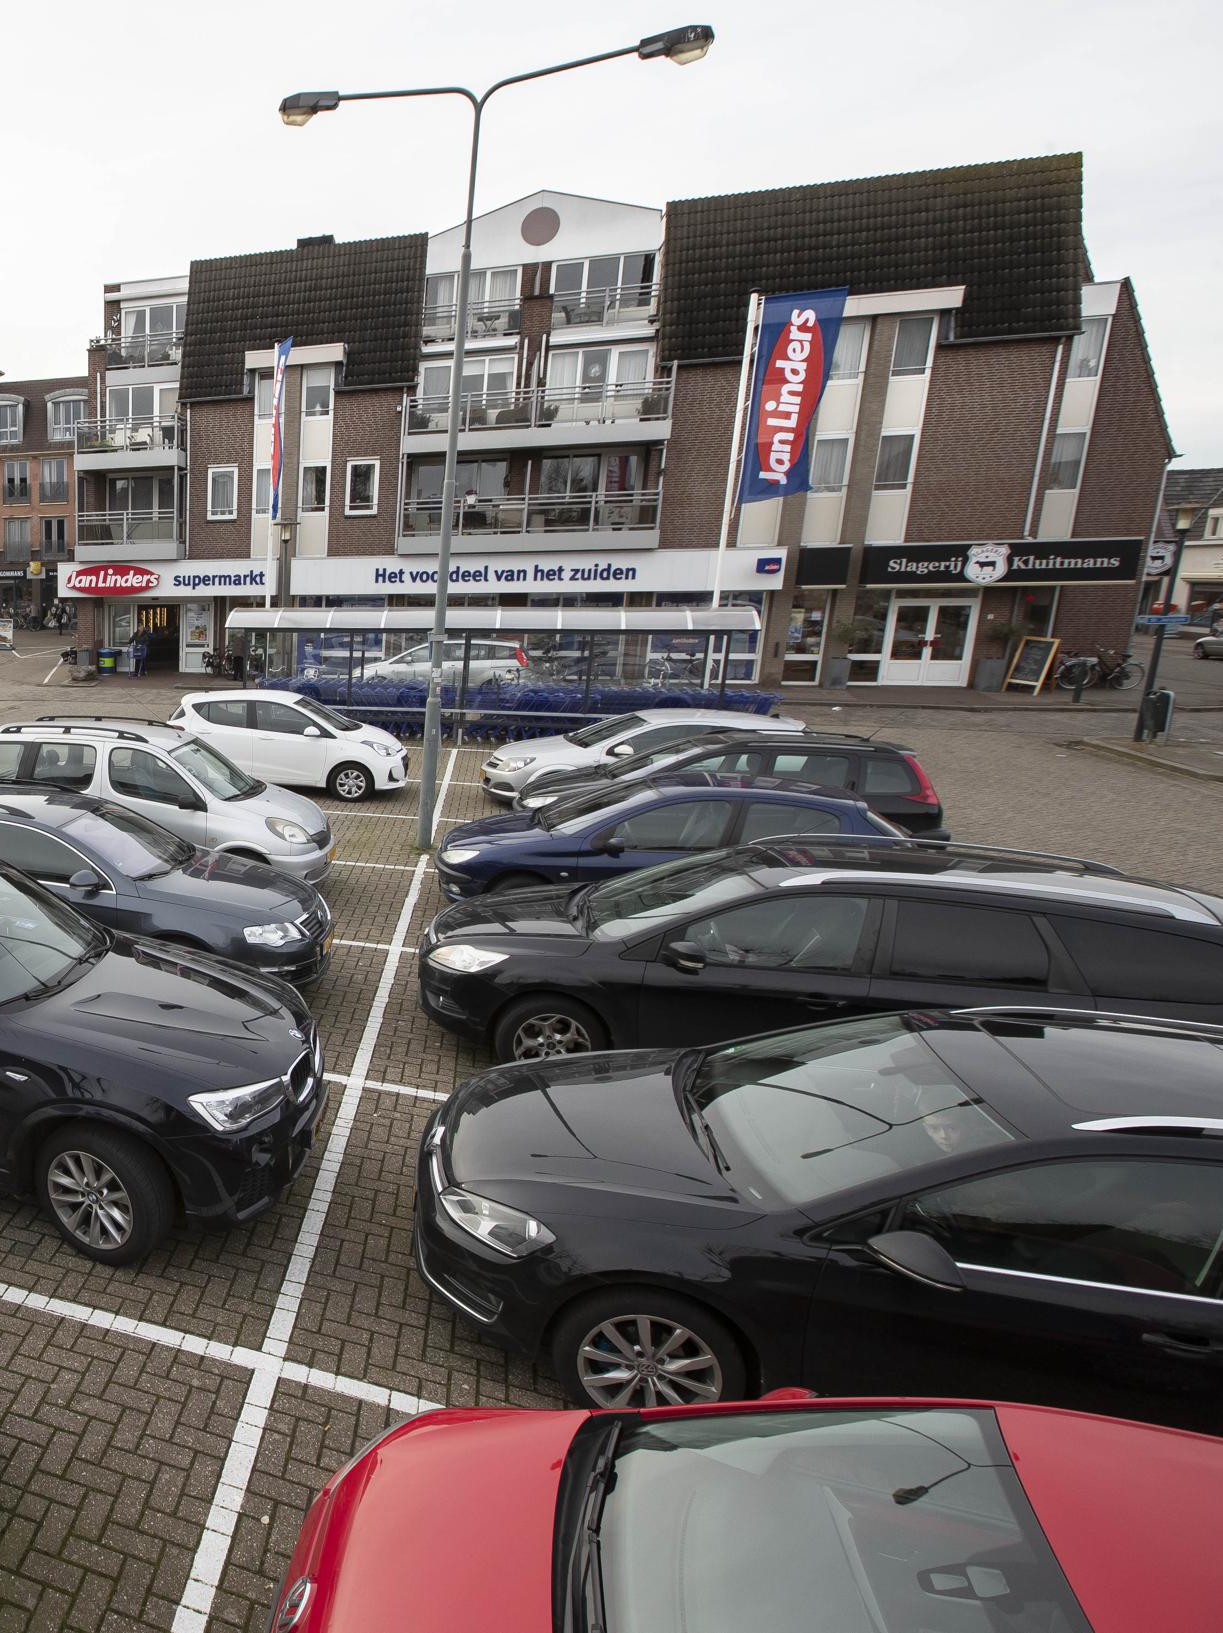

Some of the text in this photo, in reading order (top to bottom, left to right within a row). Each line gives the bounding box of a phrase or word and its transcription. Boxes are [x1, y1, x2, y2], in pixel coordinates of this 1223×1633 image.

[759, 308, 816, 485] Jan Linders
[374, 567, 405, 584] Het
[494, 570, 527, 582] van
[533, 564, 565, 582] het
[569, 563, 637, 581] zuiden
[887, 555, 1121, 575] Slagerij Kluitmans
[66, 568, 266, 590] Jan Linders supermarkt
